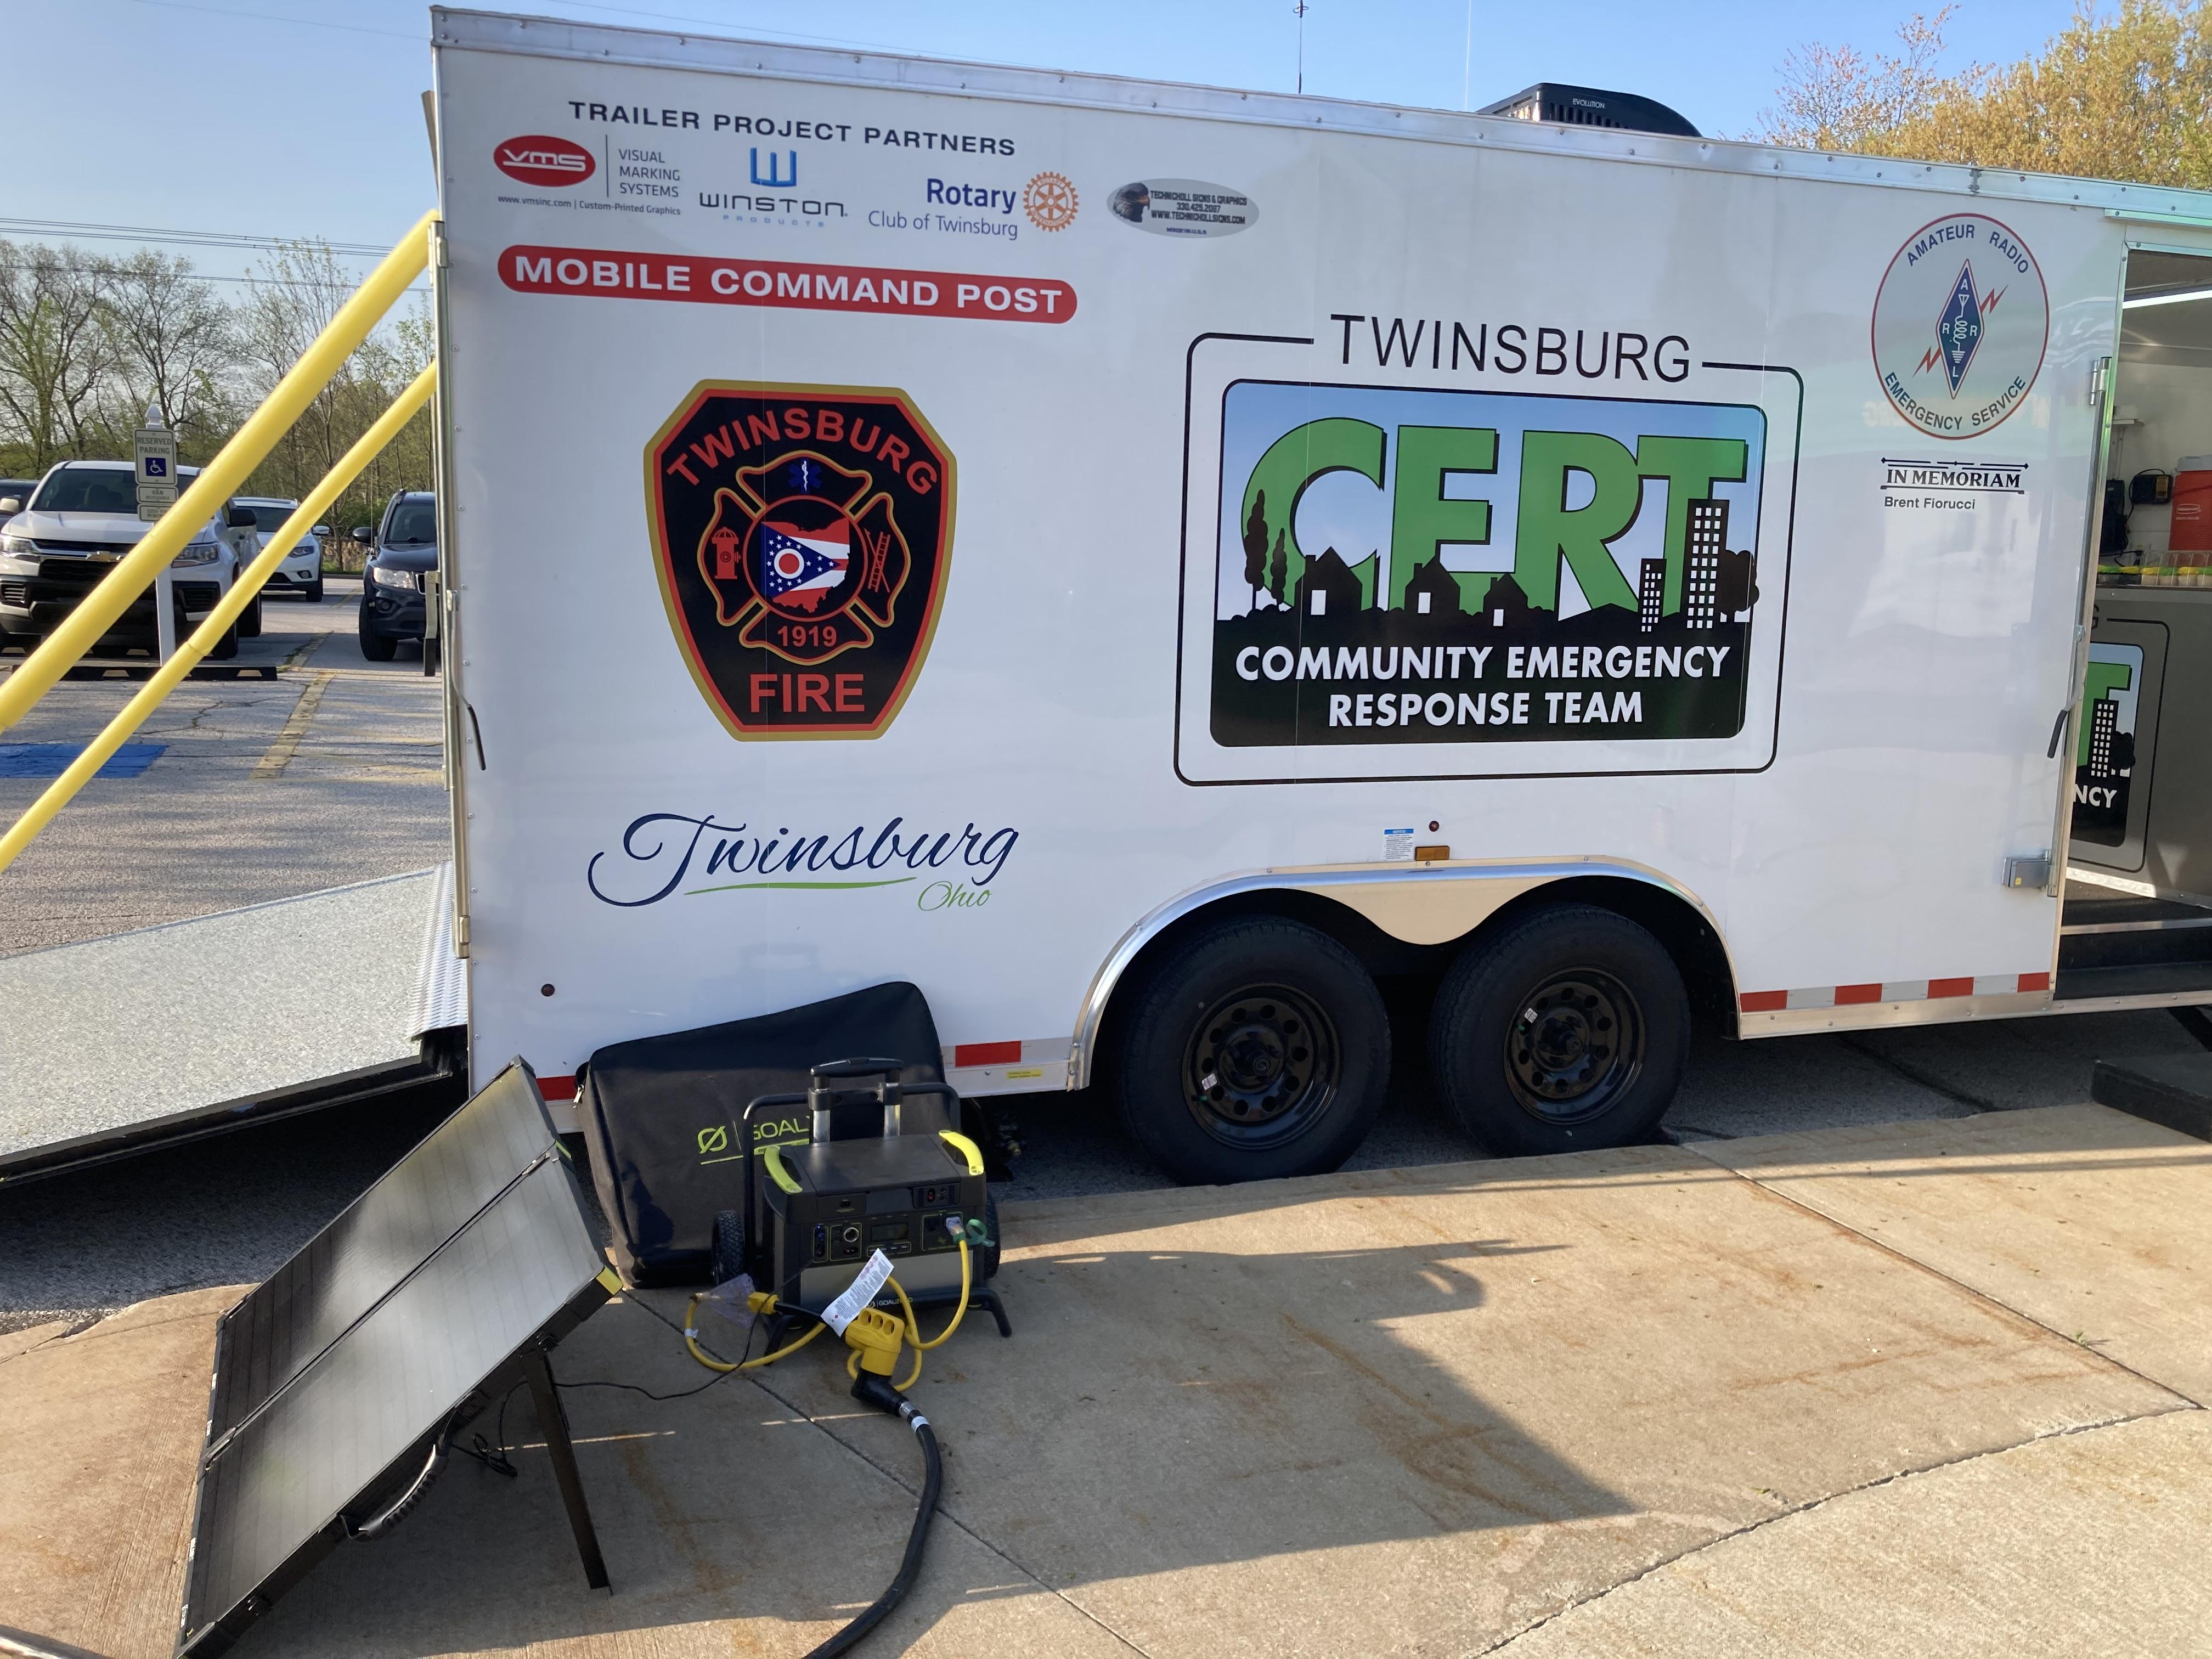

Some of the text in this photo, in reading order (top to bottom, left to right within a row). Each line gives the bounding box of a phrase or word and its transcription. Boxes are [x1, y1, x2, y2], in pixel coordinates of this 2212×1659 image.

[1572, 98, 1605, 109] EVOLUTION
[568, 101, 1015, 156] TRAILER PROJECT PARTNERS
[619, 148, 665, 163] VISUAL
[619, 165, 681, 182] MARKING
[498, 195, 681, 217] www.vmsinc.com Custom-Printed Graphics
[620, 183, 679, 198] SYSTEMS
[927, 178, 1017, 215] Rotary
[1212, 195, 1216, 204] &
[723, 215, 824, 227] PRODUCTS
[868, 210, 1018, 241] Club of Twinsburg
[1907, 224, 2030, 274] AMATEUR RADIO
[515, 255, 1063, 314] MOBILE COMMAND POST
[1330, 314, 1690, 383] TWINSBURG
[1884, 372, 2027, 431] EMERGENCY SERVICE
[137, 437, 172, 445] RESERVED
[667, 408, 938, 495] TWINSBURG
[1887, 469, 2021, 488] IN MEMORIAM
[1241, 416, 1749, 612] CERT
[1884, 496, 1976, 510] Brent Fiorucci
[777, 625, 837, 648] 1919
[1236, 645, 1731, 683] COMMUNITY EMERGENCY
[749, 674, 866, 713] FIRE
[1328, 691, 1643, 728] RESPONSE TEAM
[588, 813, 1019, 908] Twinsburg
[918, 881, 993, 912] Ohio
